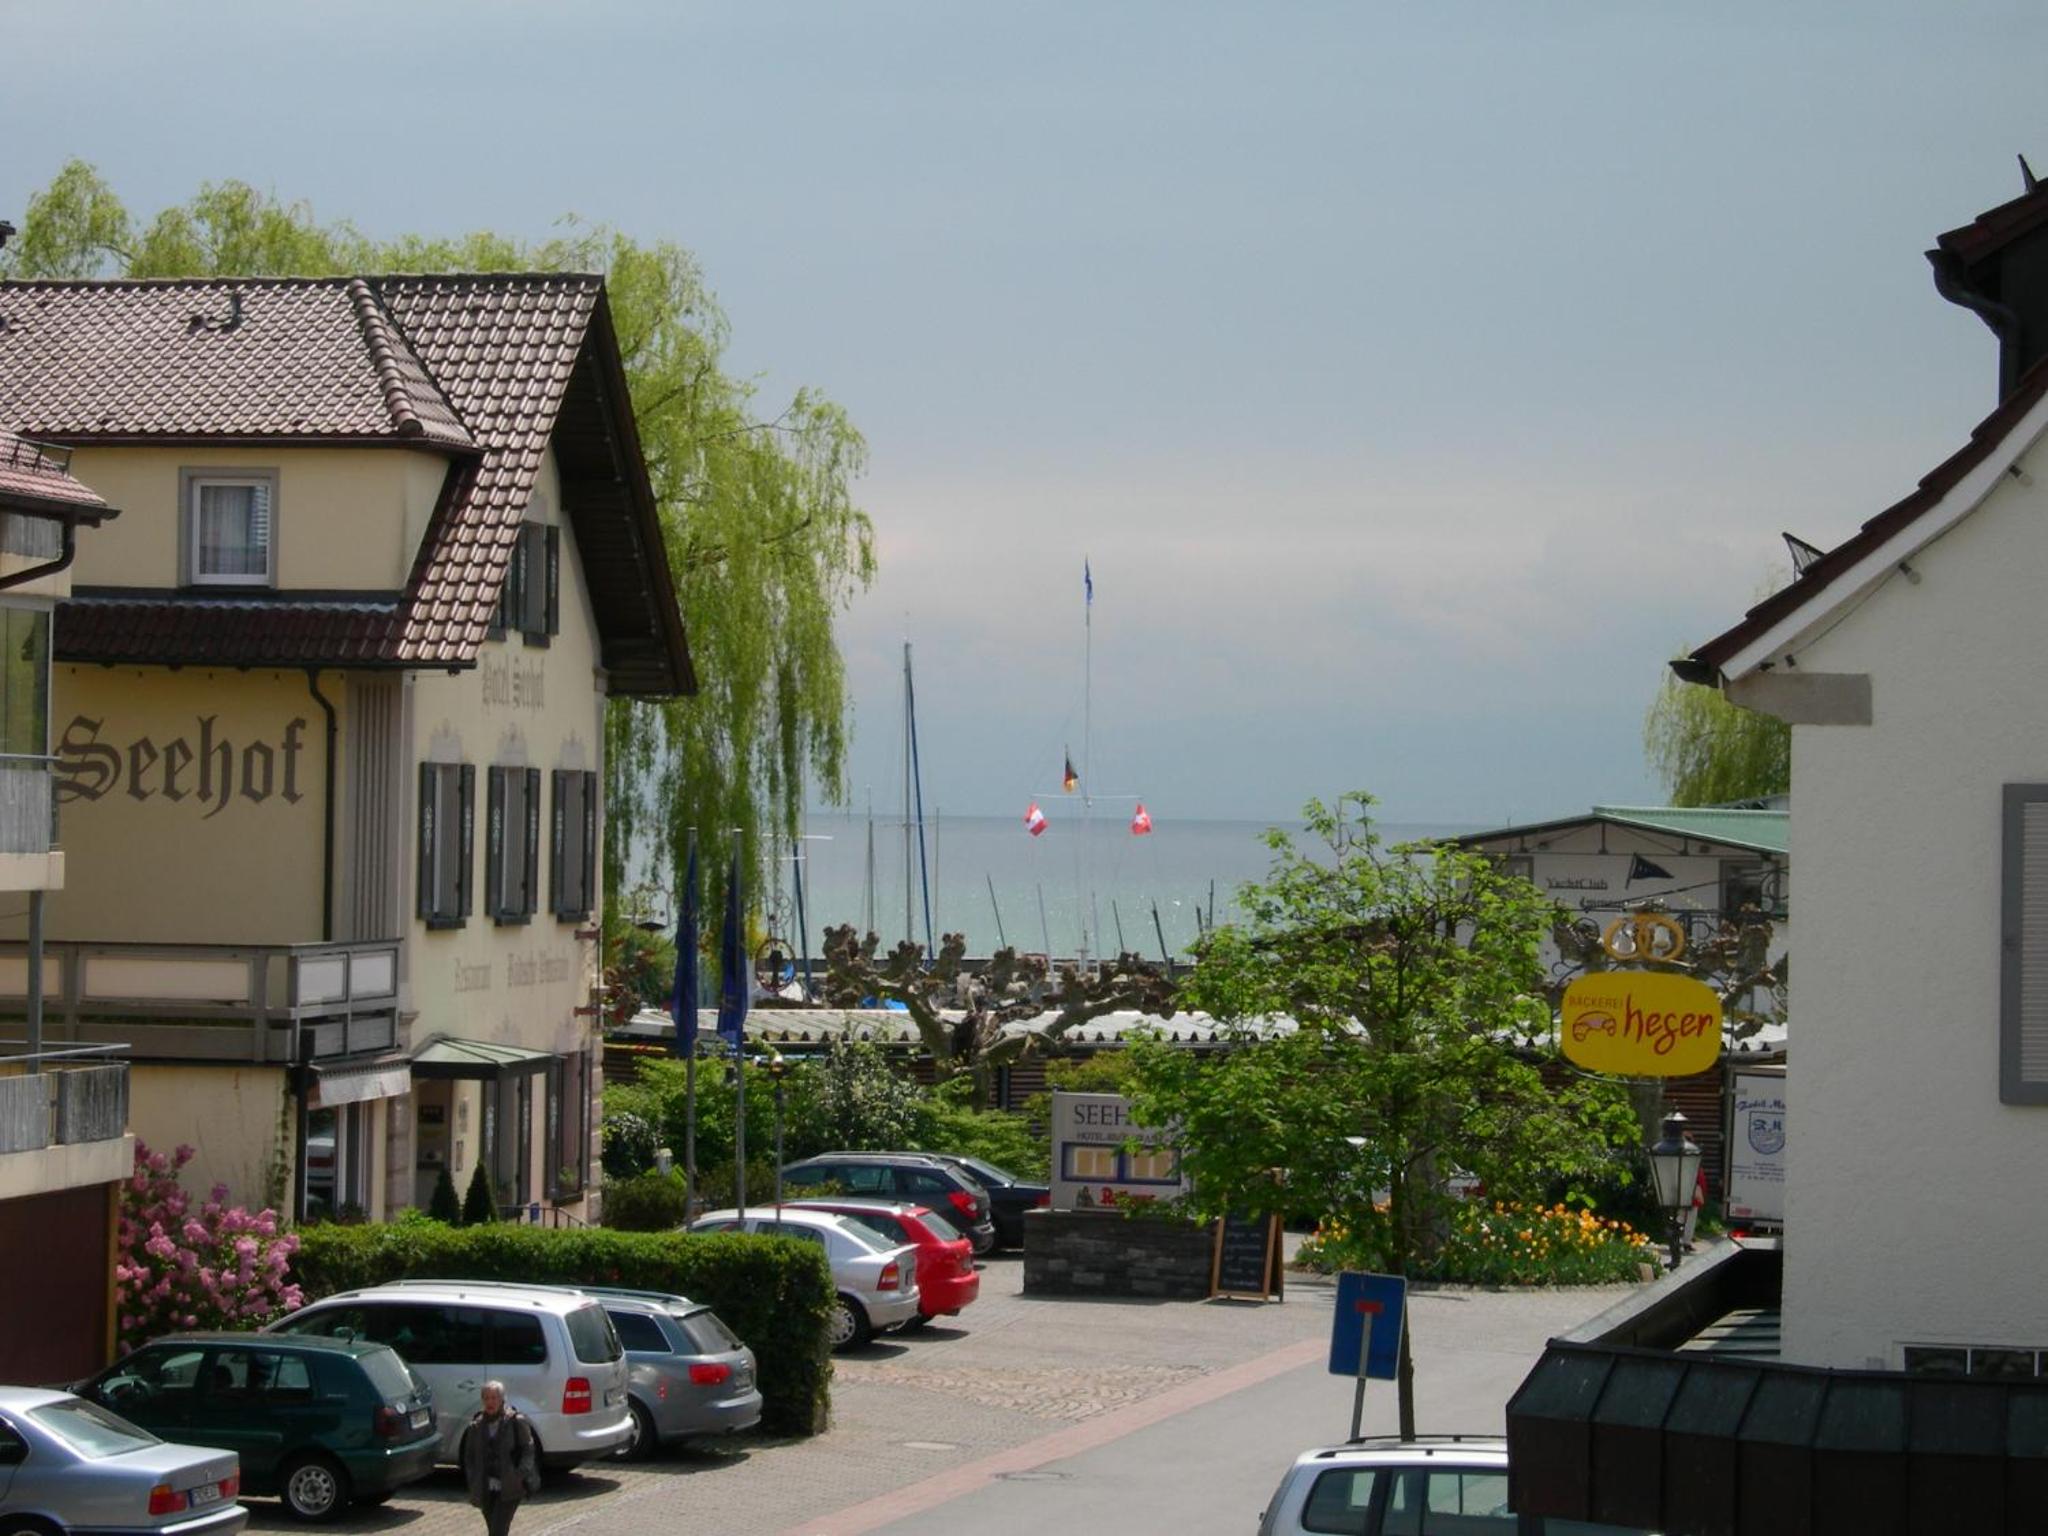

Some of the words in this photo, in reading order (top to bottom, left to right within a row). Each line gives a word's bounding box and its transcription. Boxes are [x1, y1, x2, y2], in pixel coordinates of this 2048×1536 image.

[53, 713, 307, 821] Seehof
[1623, 993, 1713, 1055] heger
[1073, 1103, 1133, 1127] SEEH
